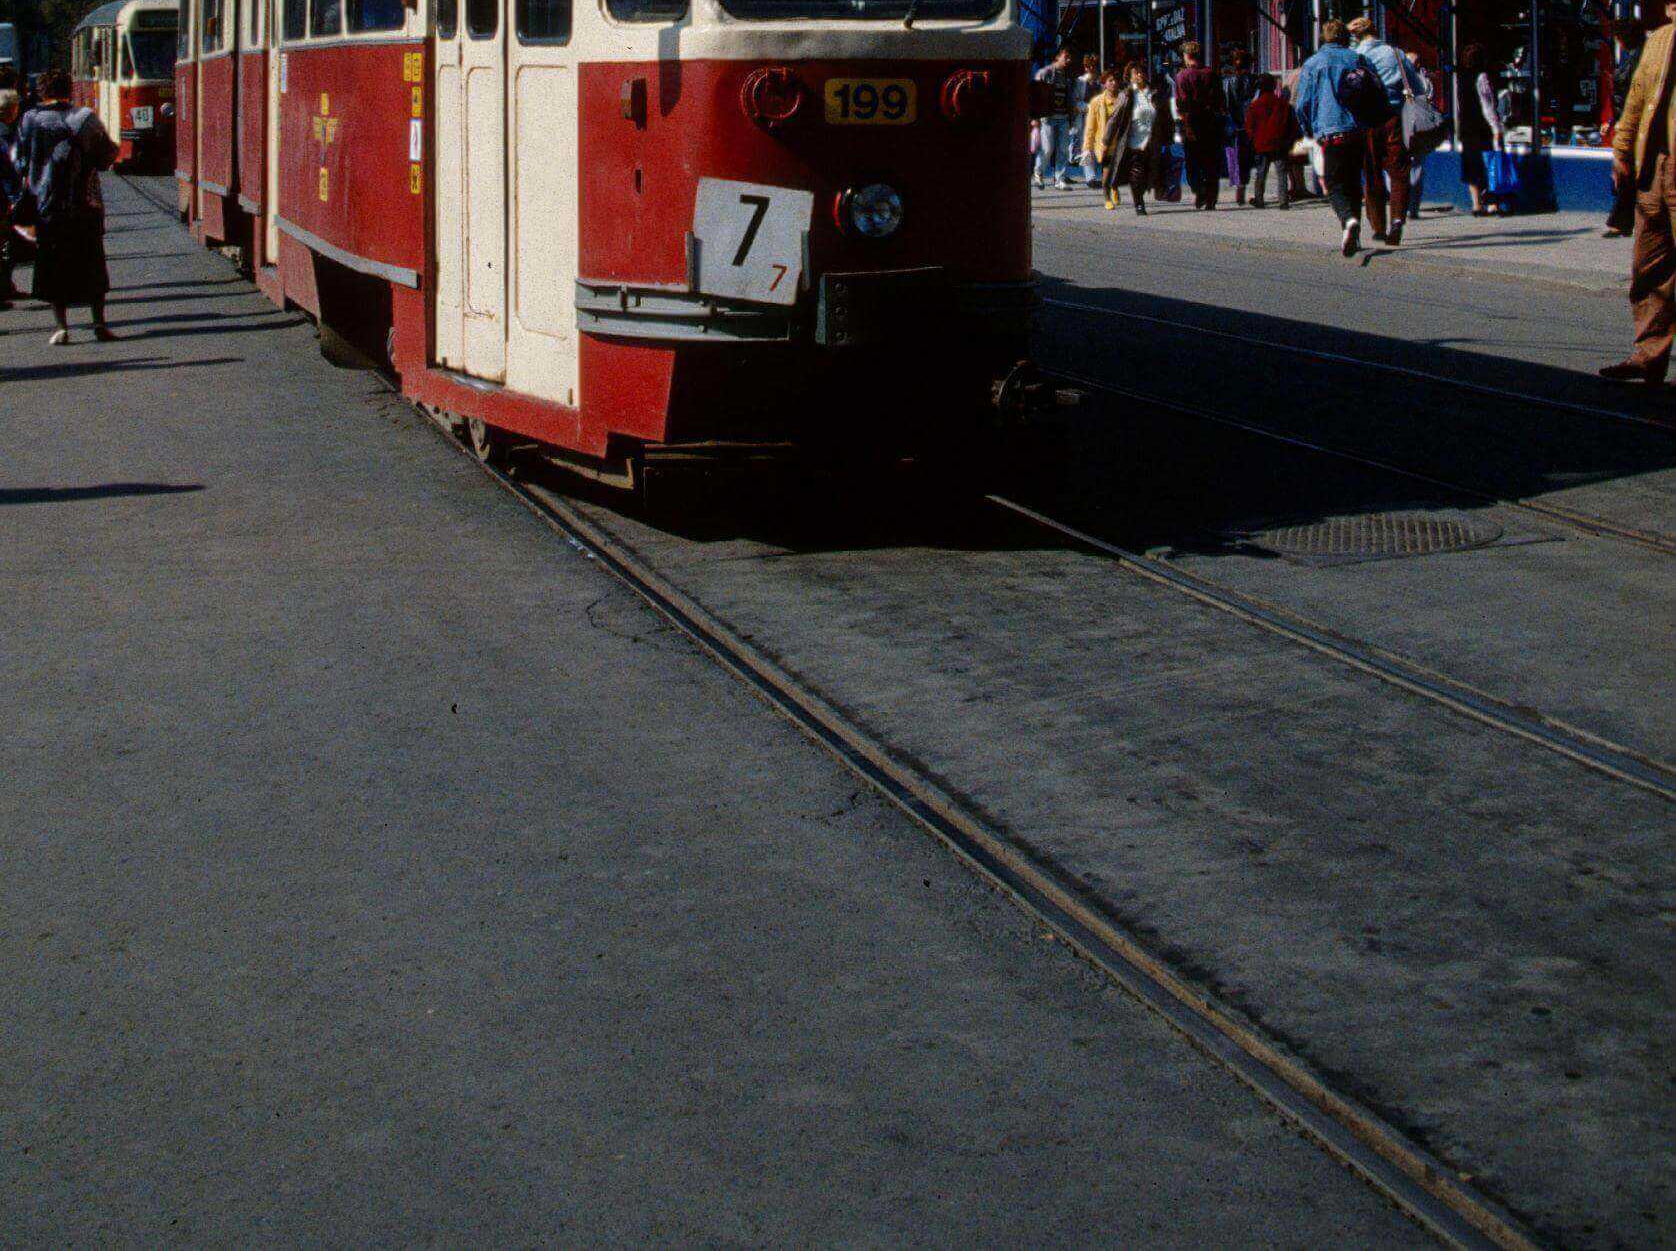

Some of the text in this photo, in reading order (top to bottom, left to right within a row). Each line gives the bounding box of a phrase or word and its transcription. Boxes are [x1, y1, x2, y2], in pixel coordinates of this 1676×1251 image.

[834, 83, 908, 119] 199
[732, 194, 771, 266] 7
[770, 263, 788, 292] 7
